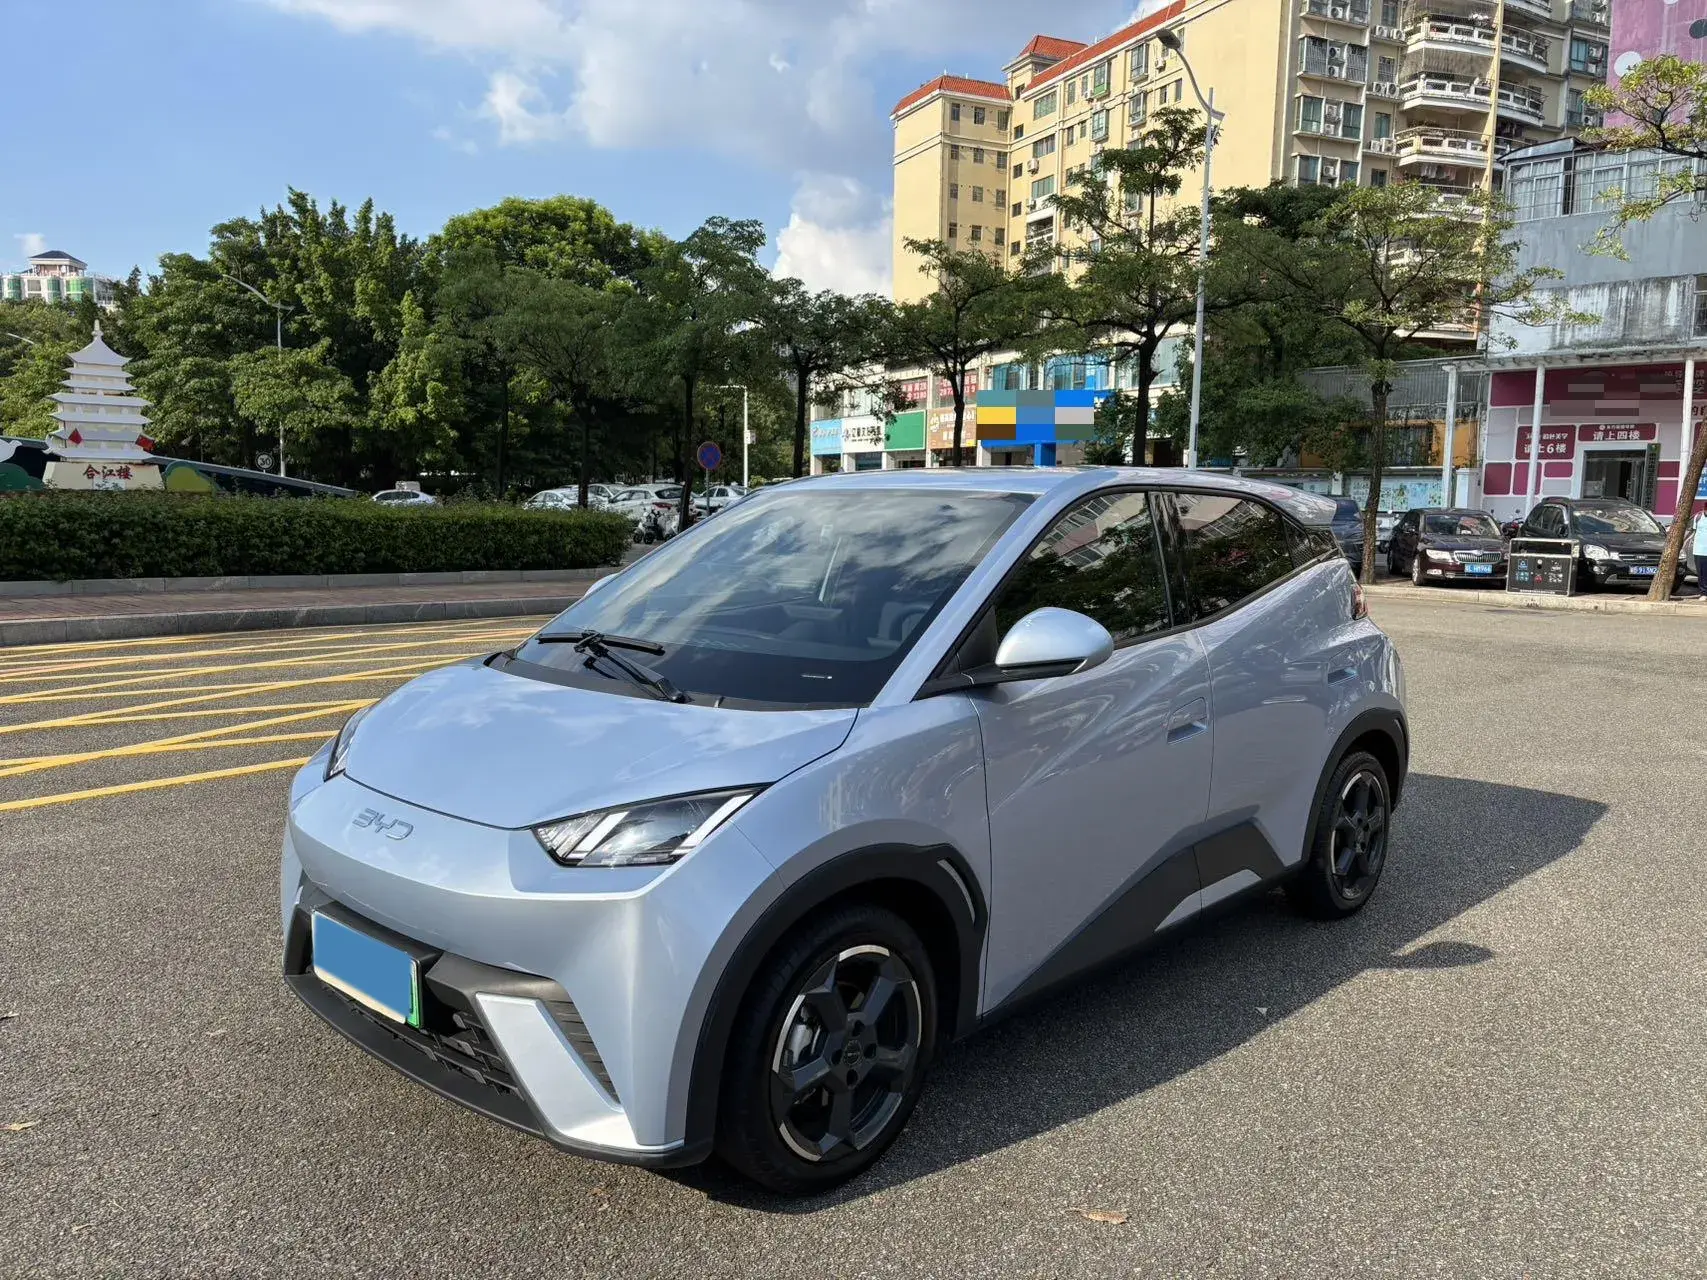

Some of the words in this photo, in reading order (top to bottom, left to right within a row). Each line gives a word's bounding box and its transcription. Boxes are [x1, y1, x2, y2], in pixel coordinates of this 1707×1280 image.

[1593, 430, 1641, 441] 请上四楼
[259, 457, 271, 466] 30
[82, 464, 133, 480] 合江楼
[352, 808, 414, 841] BYD
